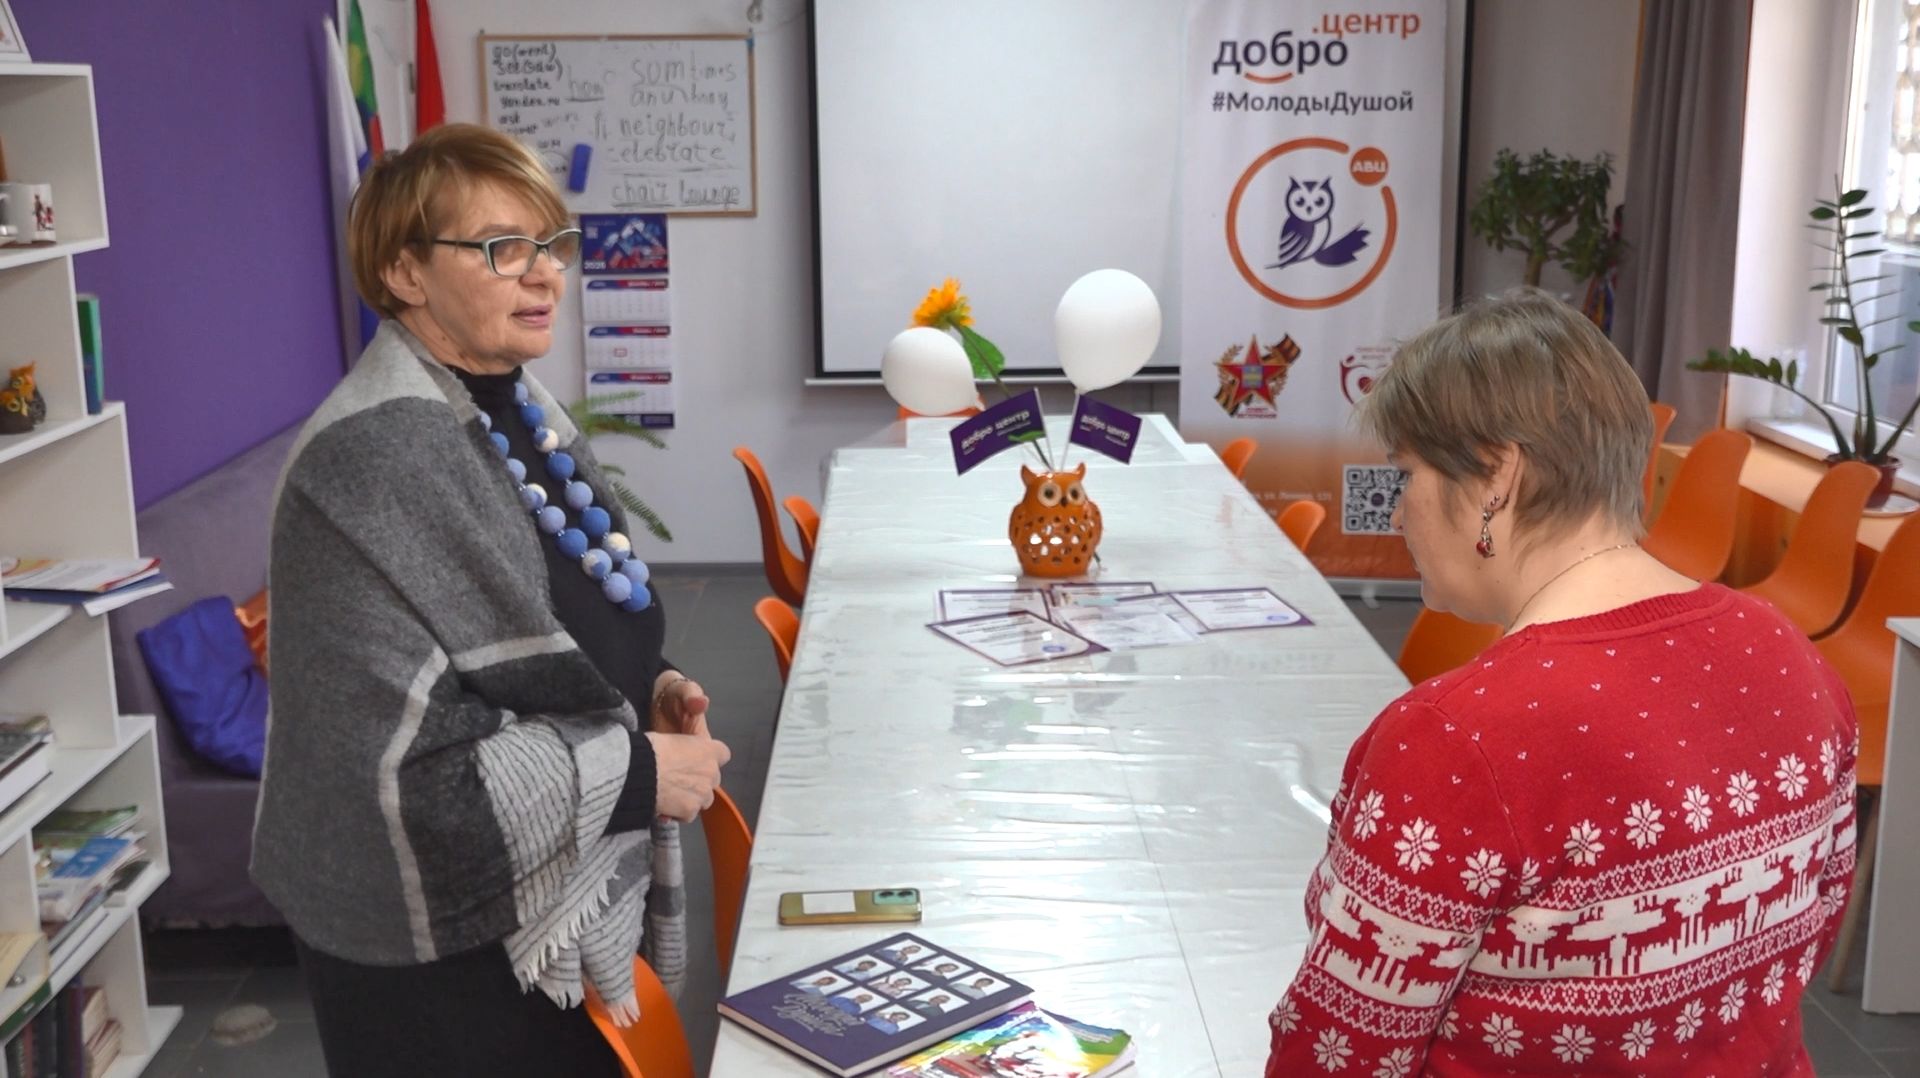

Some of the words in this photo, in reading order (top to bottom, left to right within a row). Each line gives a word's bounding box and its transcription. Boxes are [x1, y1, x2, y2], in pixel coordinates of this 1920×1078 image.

[1212, 30, 1348, 74] добро
[1212, 91, 1413, 115] #МолодыДушой
[961, 425, 994, 450] добро
[995, 410, 1031, 430] центр
[1080, 414, 1106, 431] добро
[1107, 425, 1131, 441] центр
